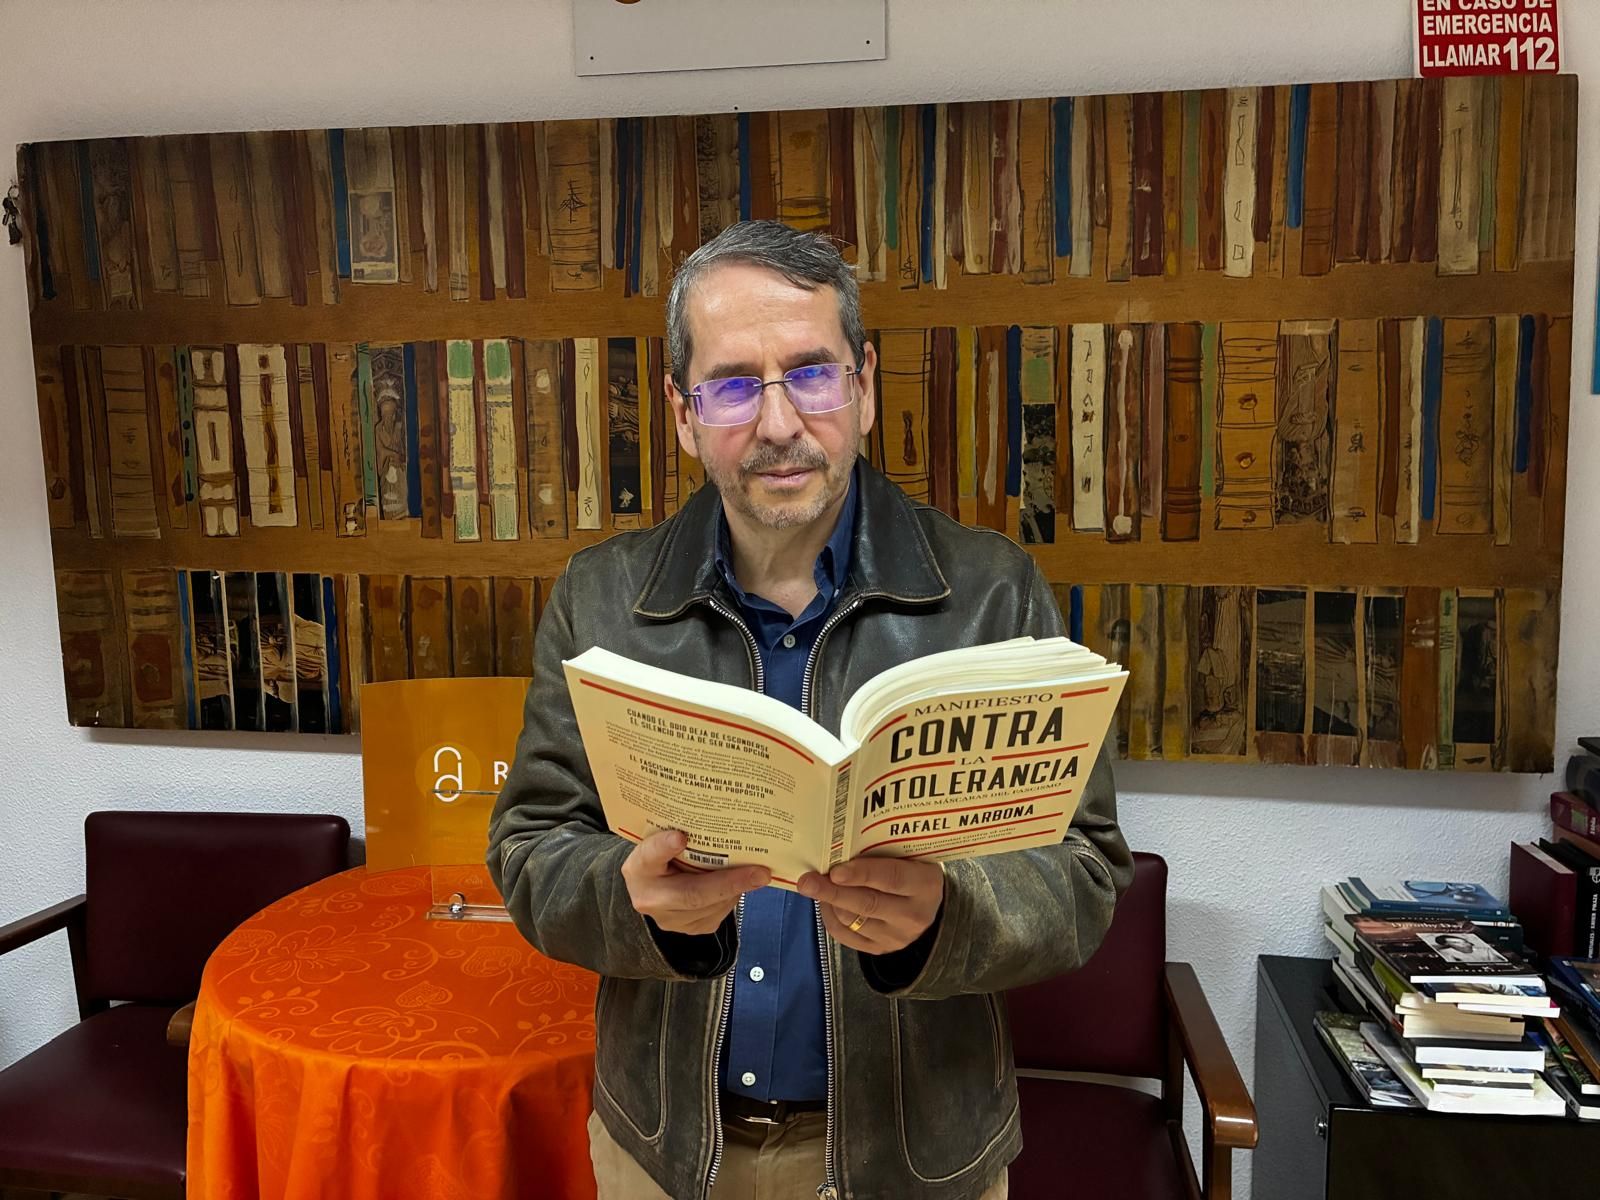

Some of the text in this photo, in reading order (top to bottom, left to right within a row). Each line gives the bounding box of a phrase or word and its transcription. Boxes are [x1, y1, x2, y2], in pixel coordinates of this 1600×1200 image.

[1423, 0, 1451, 11] EN
[1423, 13, 1552, 35] EMERGENCIA
[1423, 37, 1556, 71] LLAMAR 112
[914, 692, 1054, 717] MANIFIESTO
[627, 708, 656, 724] CUANDO
[658, 718, 667, 727] EL
[669, 722, 687, 732] ODIO
[689, 726, 708, 737] DEJA
[710, 731, 720, 739] DE
[630, 717, 639, 726] EL
[641, 721, 674, 737] SILENCIO
[676, 731, 695, 742] DEJA
[697, 737, 707, 745] DE
[709, 738, 724, 747] SER
[725, 742, 741, 752] UNA
[890, 706, 1063, 764] CONTRA
[629, 754, 638, 762] EL
[639, 756, 674, 775] FASCISMO
[675, 769, 697, 780] PUEDE
[699, 775, 733, 787] CAMBIAR
[960, 755, 987, 766] LA
[640, 765, 658, 776] PERO
[659, 772, 683, 783] NUNCA
[684, 778, 712, 790] CAMBIA
[714, 784, 723, 792] DE
[862, 755, 1079, 819] INTOLERANCIA
[893, 802, 930, 813] NUEVAS
[933, 793, 988, 806] MÁSCARAS
[990, 791, 1010, 799] DEL
[1012, 783, 1062, 795] FASCISMO
[890, 804, 1034, 836] RAFAEL NARBONA
